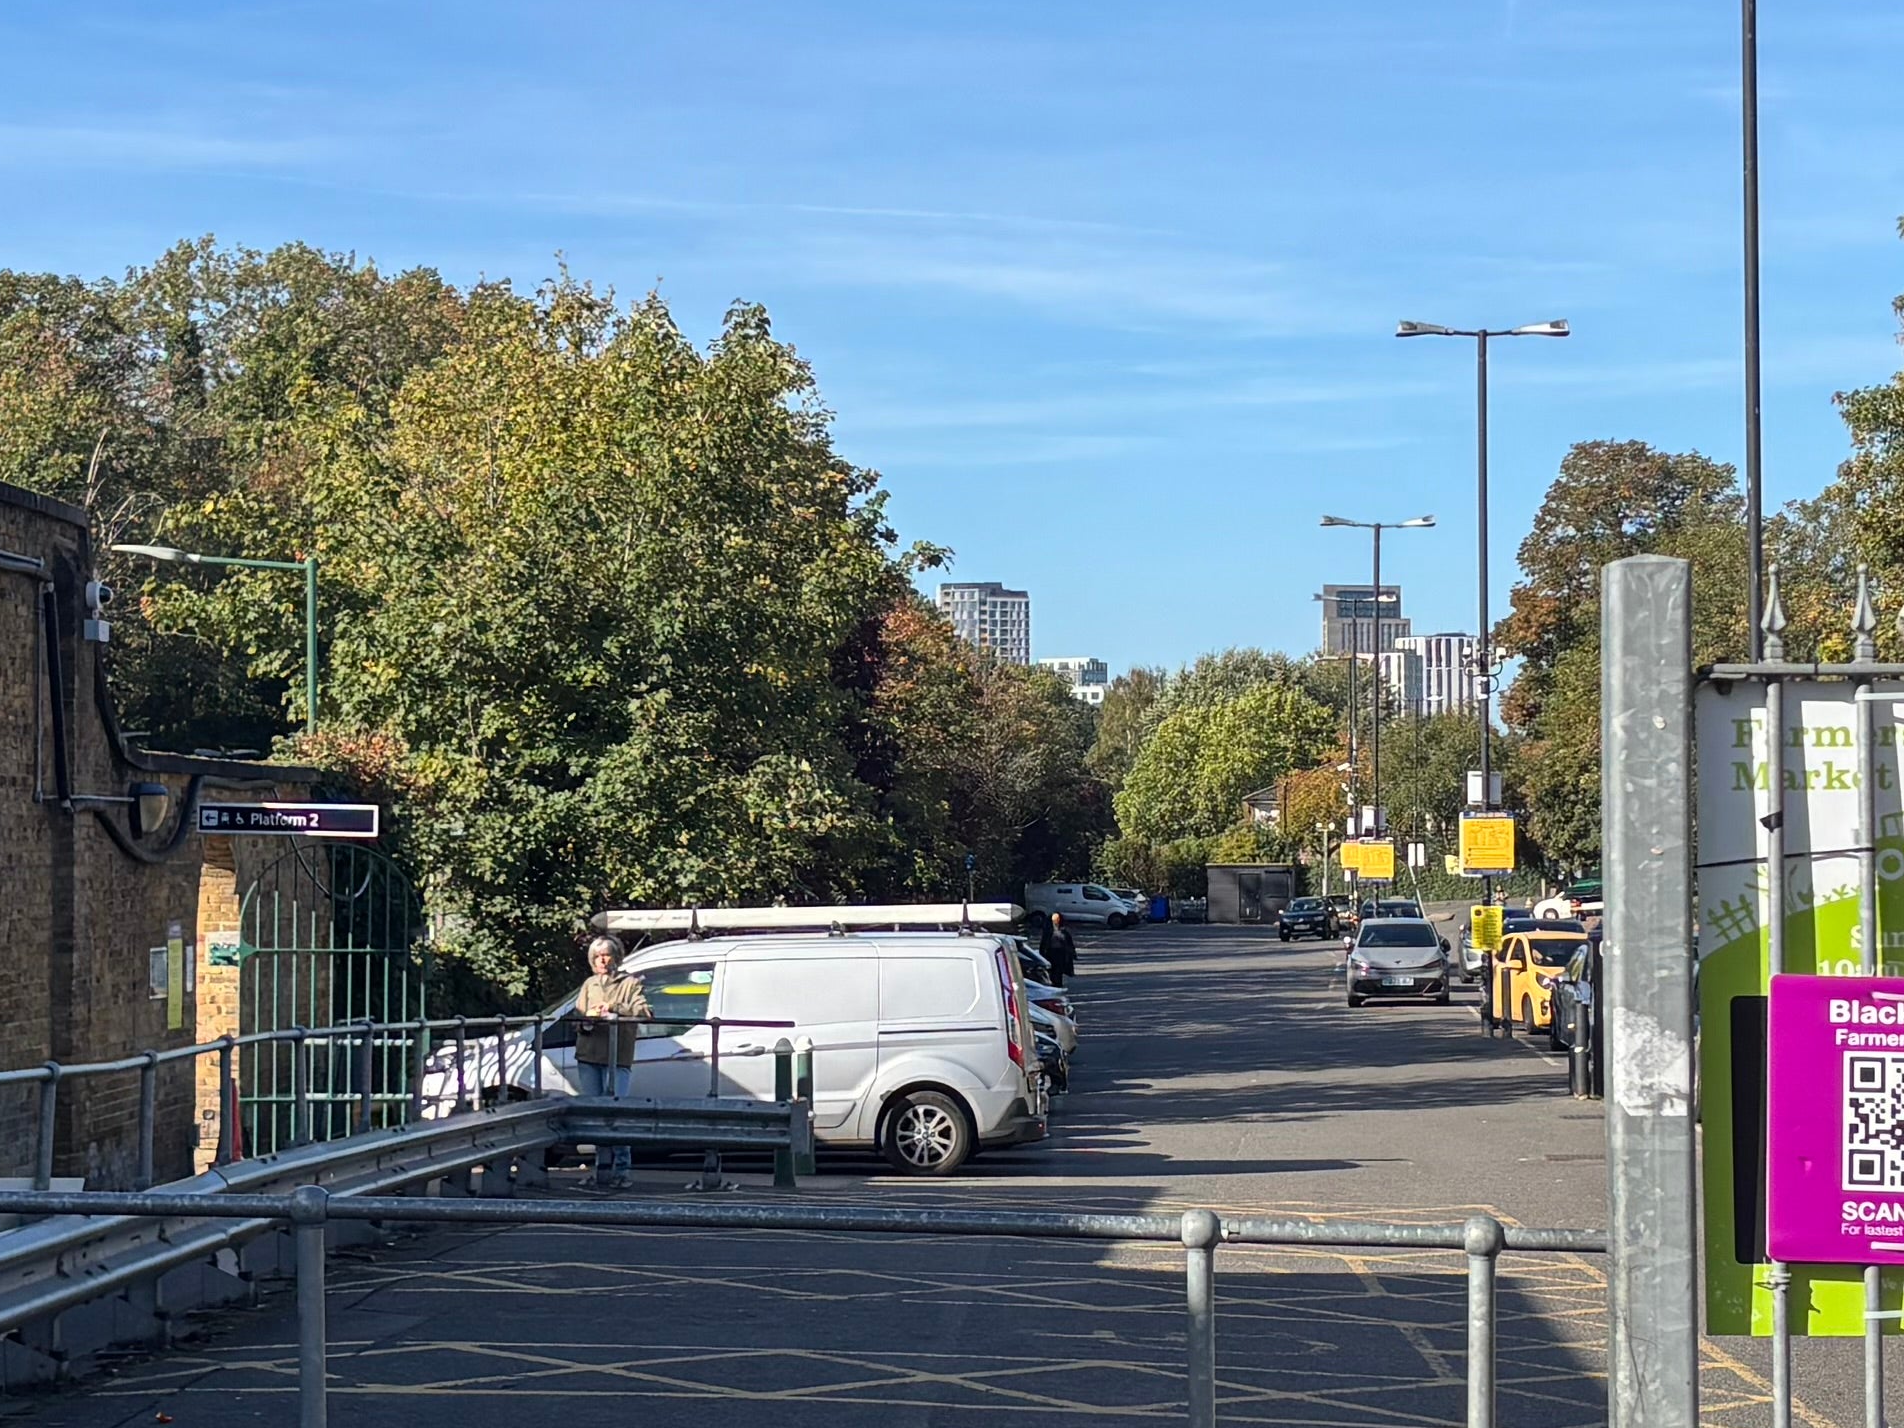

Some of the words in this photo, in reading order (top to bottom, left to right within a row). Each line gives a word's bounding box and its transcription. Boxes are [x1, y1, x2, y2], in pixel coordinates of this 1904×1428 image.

[250, 812, 307, 827] Platform
[309, 813, 319, 828] 2
[1840, 1222, 1861, 1236] For
